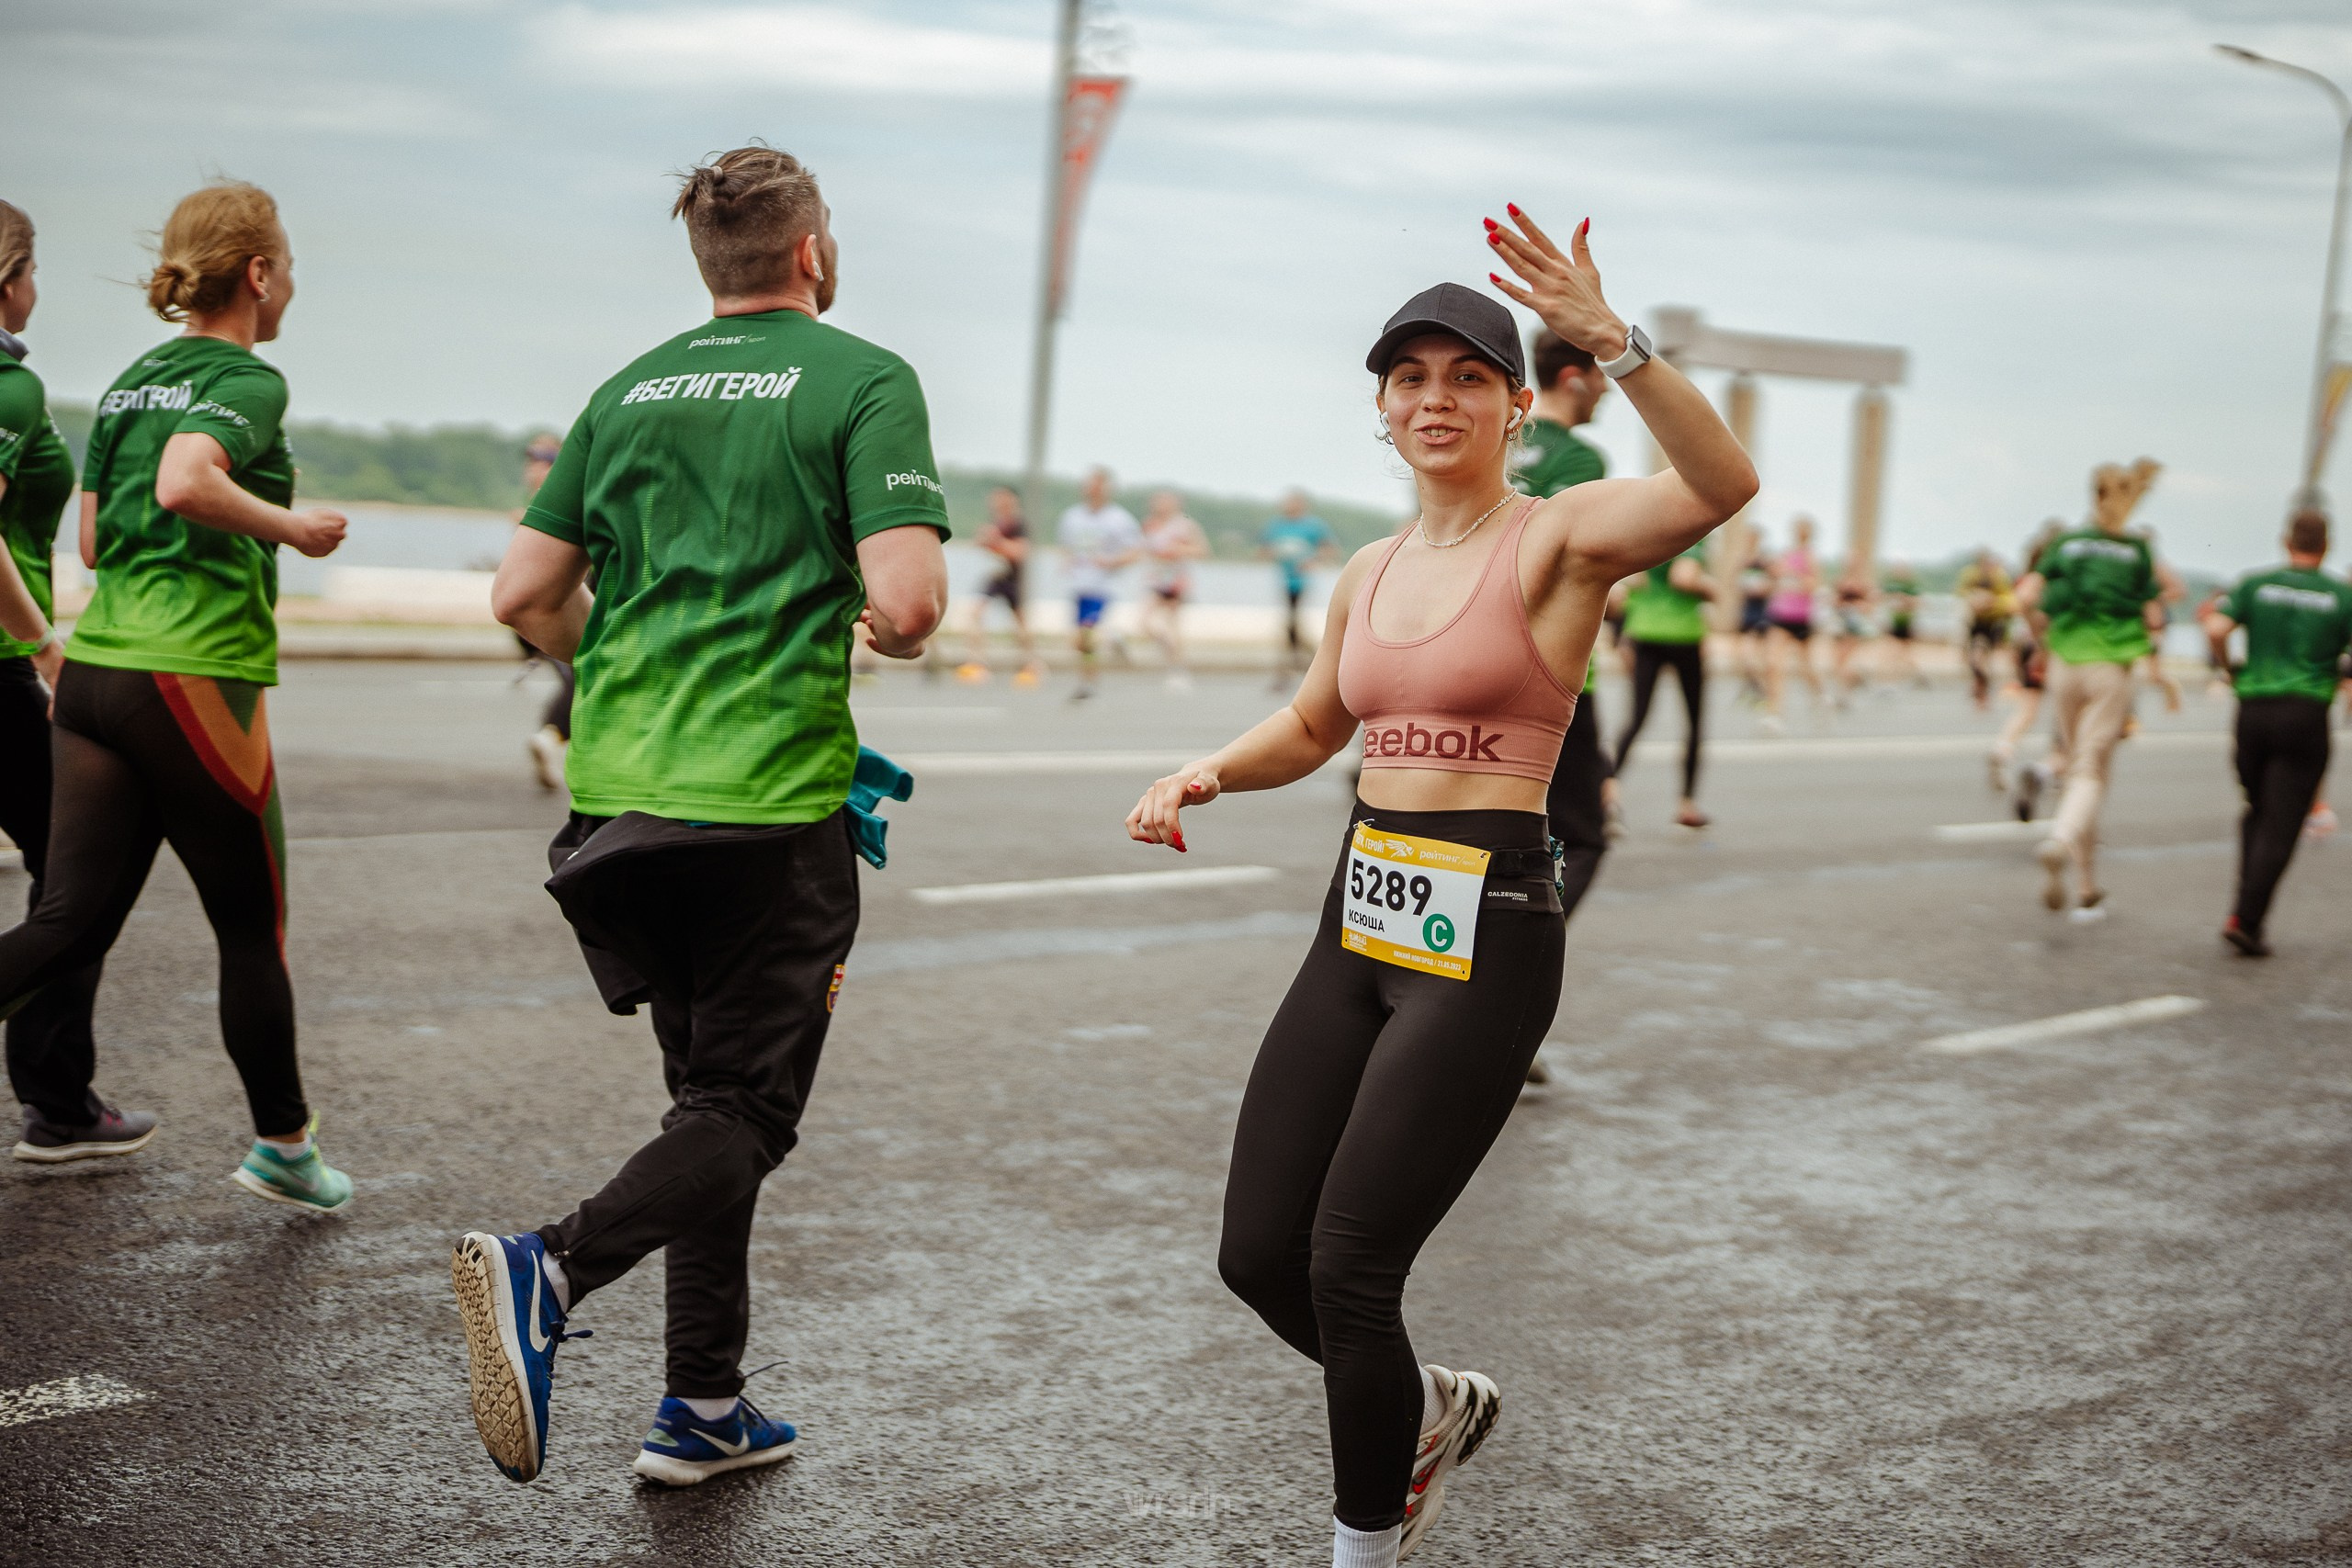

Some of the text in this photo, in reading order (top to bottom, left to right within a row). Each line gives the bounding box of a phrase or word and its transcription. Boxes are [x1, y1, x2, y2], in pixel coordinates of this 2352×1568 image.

[620, 367, 802, 405] #БЕГИГЕРОЙ
[1364, 723, 1504, 761] eebok
[1351, 858, 1432, 917] 5289
[1349, 908, 1385, 933] КСЮША
